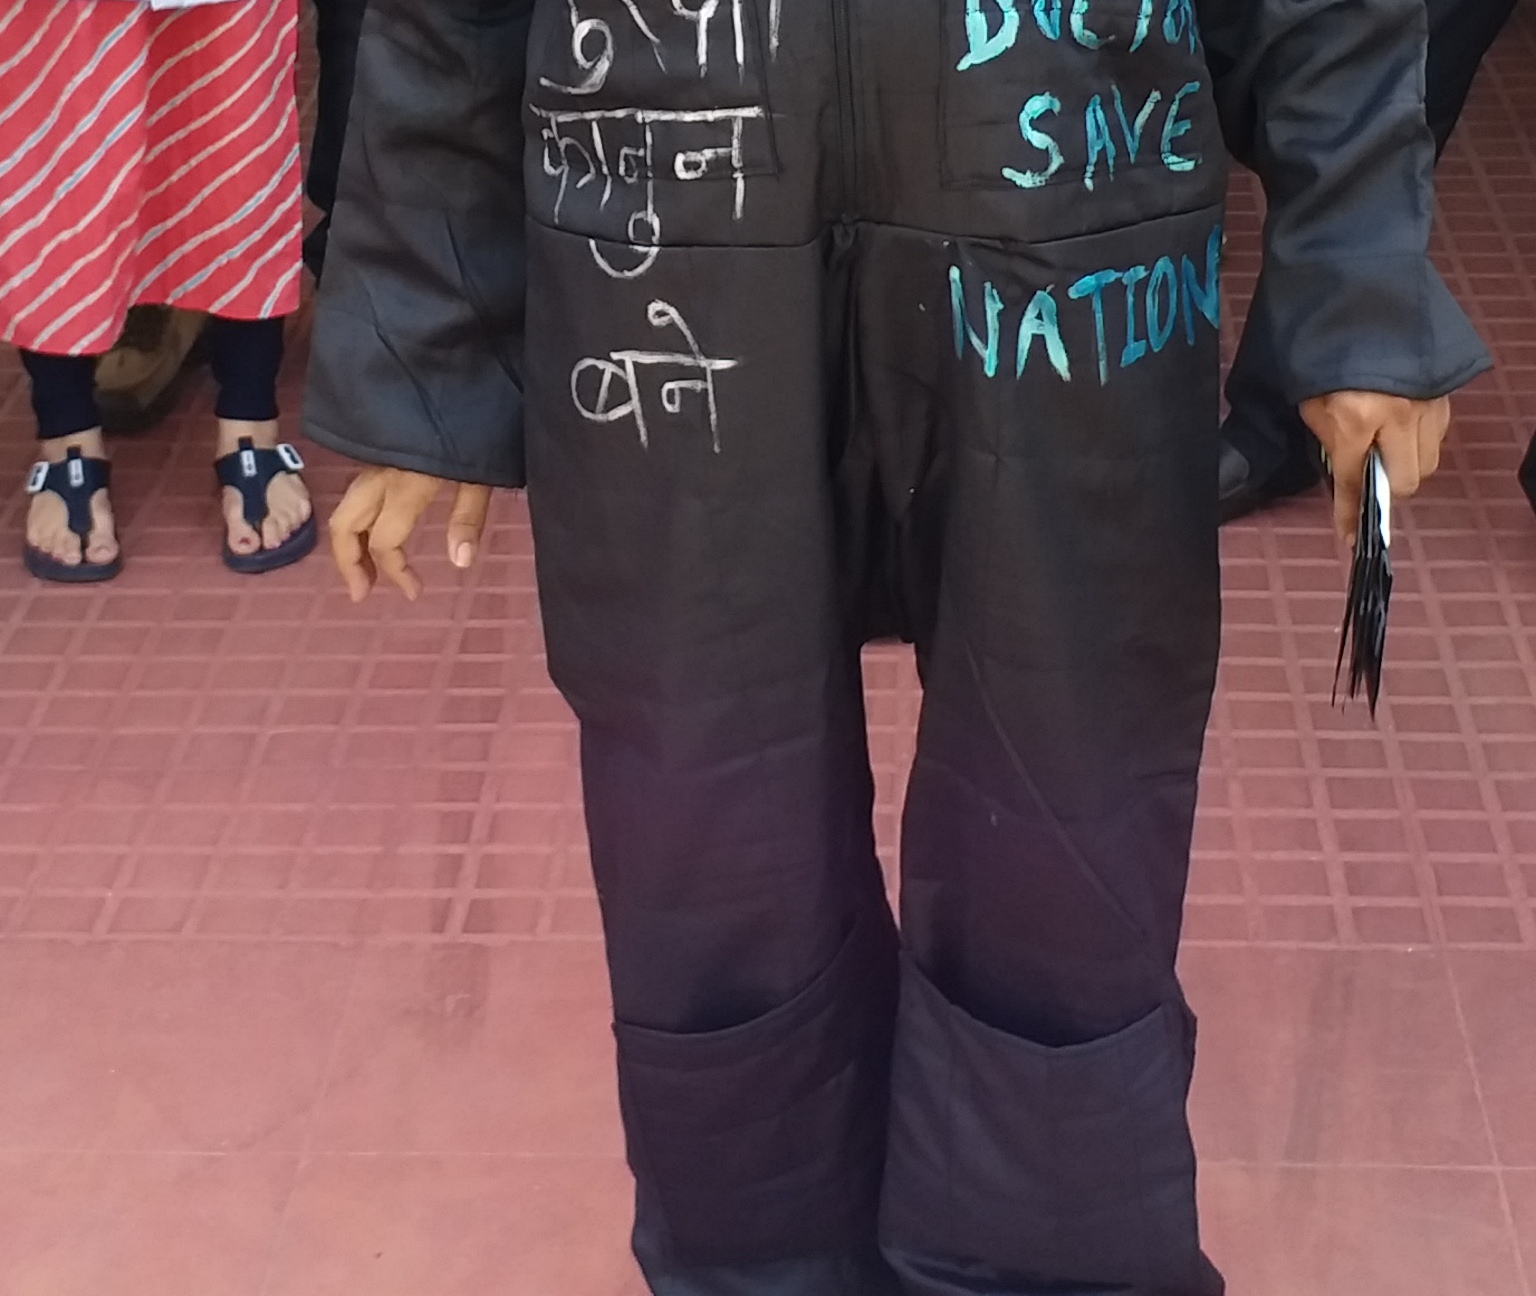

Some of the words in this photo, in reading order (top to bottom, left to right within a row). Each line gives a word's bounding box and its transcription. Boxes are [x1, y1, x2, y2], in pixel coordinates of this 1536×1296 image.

[1001, 80, 1204, 192] SAVE
[569, 298, 742, 454] बने
[947, 225, 1221, 387] NATION
